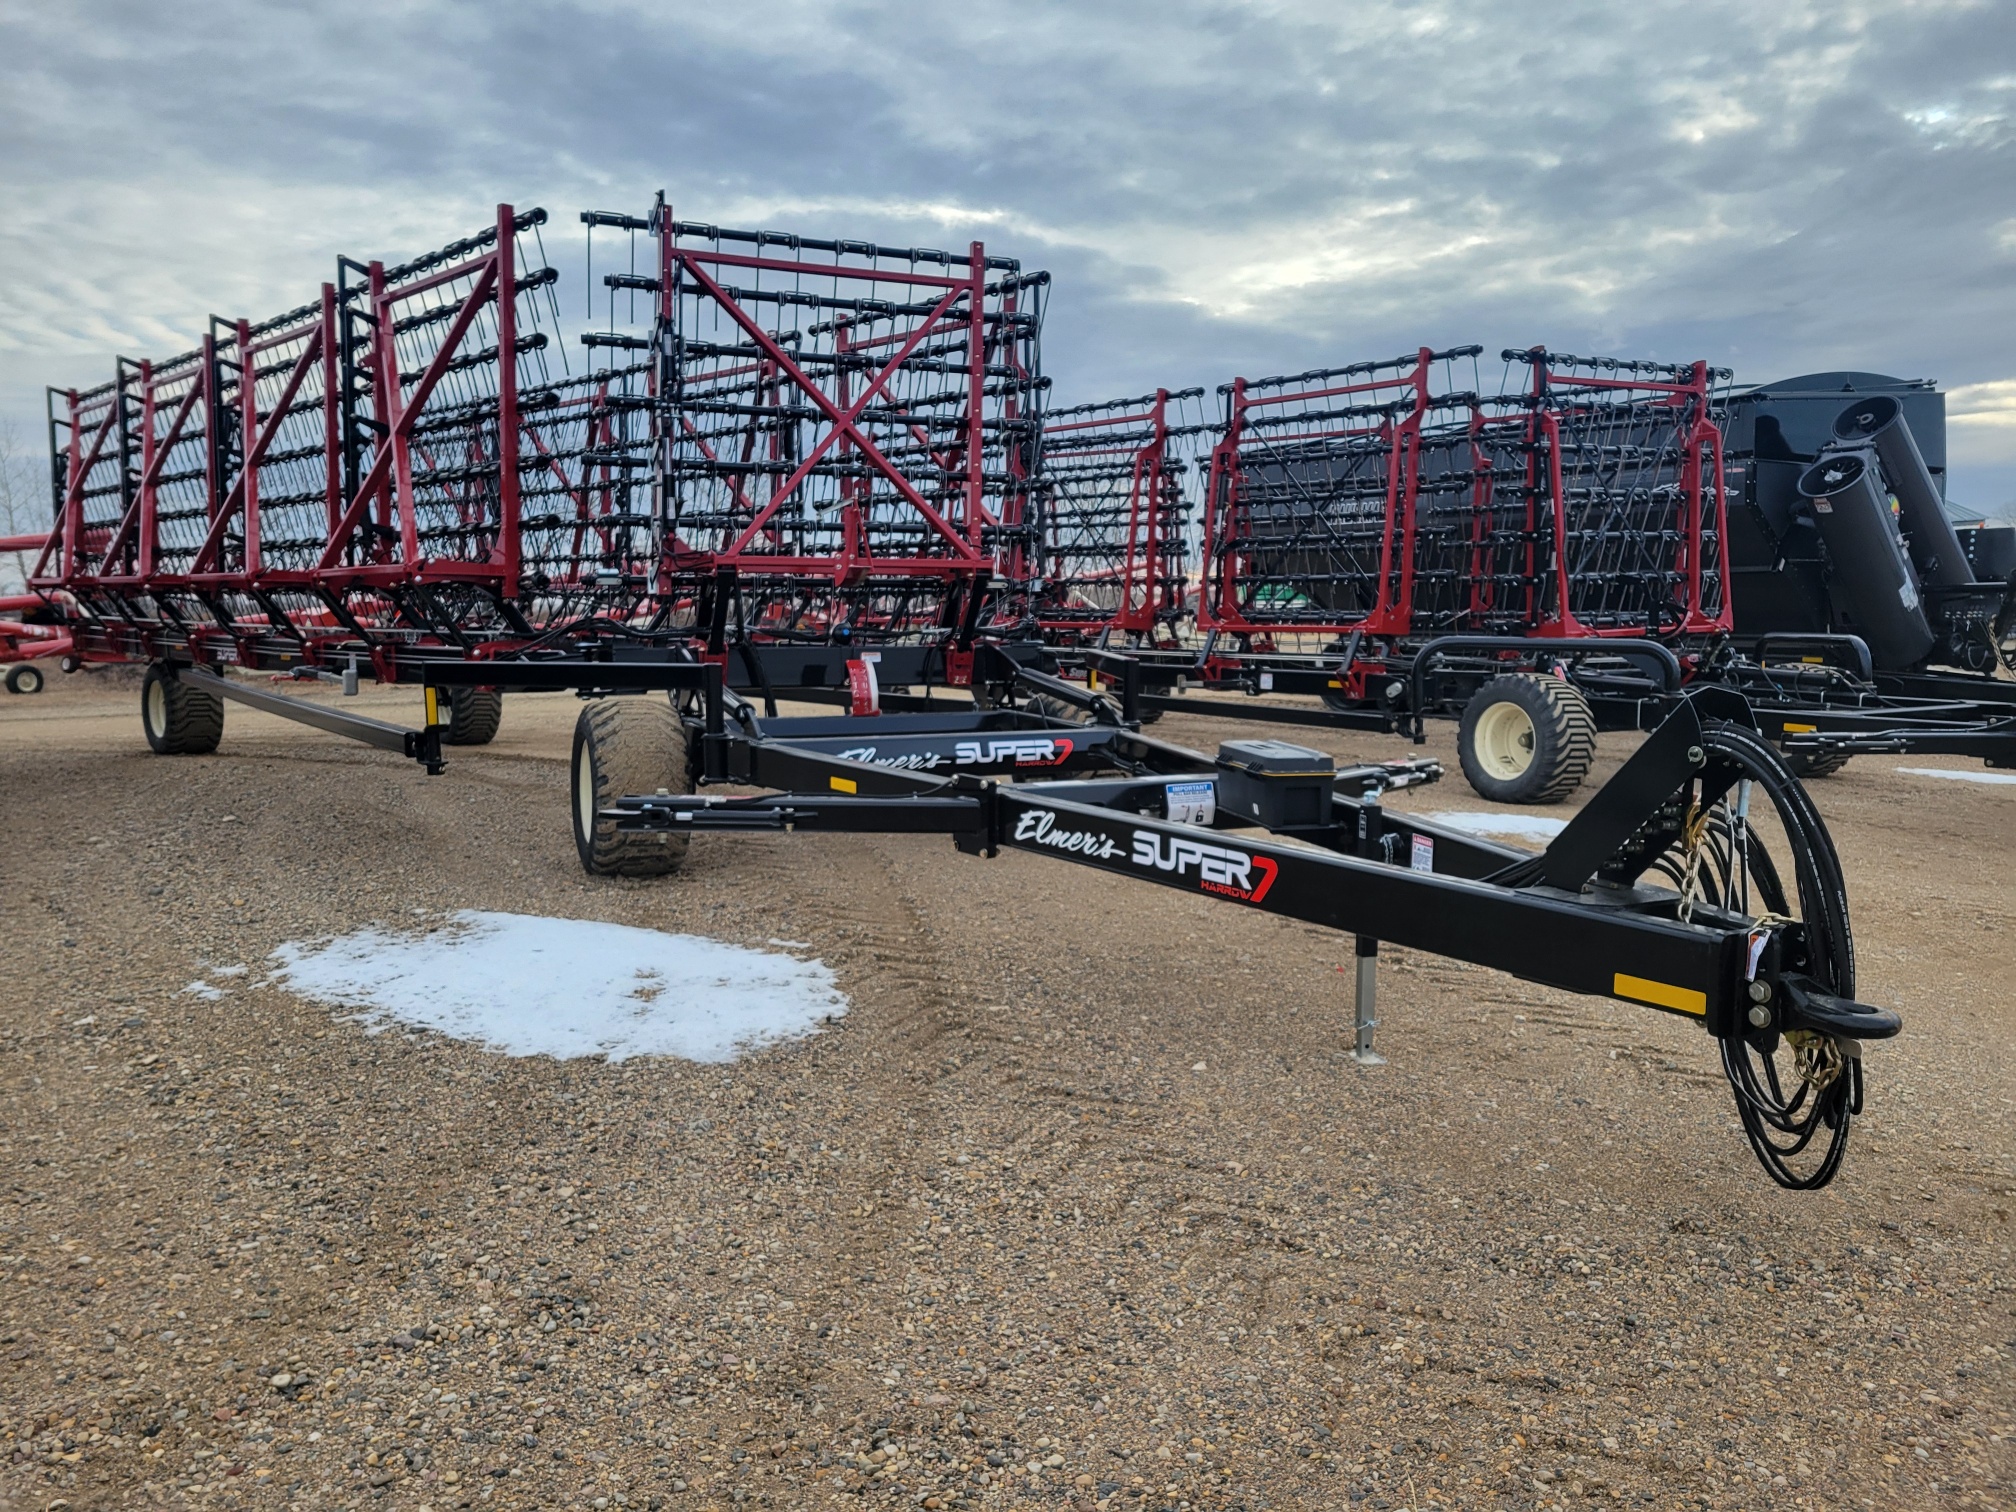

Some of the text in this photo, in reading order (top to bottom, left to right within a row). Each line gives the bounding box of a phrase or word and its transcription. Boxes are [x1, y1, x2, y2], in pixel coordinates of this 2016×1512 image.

[955, 739, 1055, 765] SUPER
[1052, 738, 1074, 766] 7
[1014, 760, 1054, 768] HARROW
[1172, 784, 1207, 792] IMPORTANT
[1416, 836, 1432, 847] DANGER
[1015, 809, 1279, 903] Elmer's SUPER 7
[1200, 880, 1252, 900] HARROW
